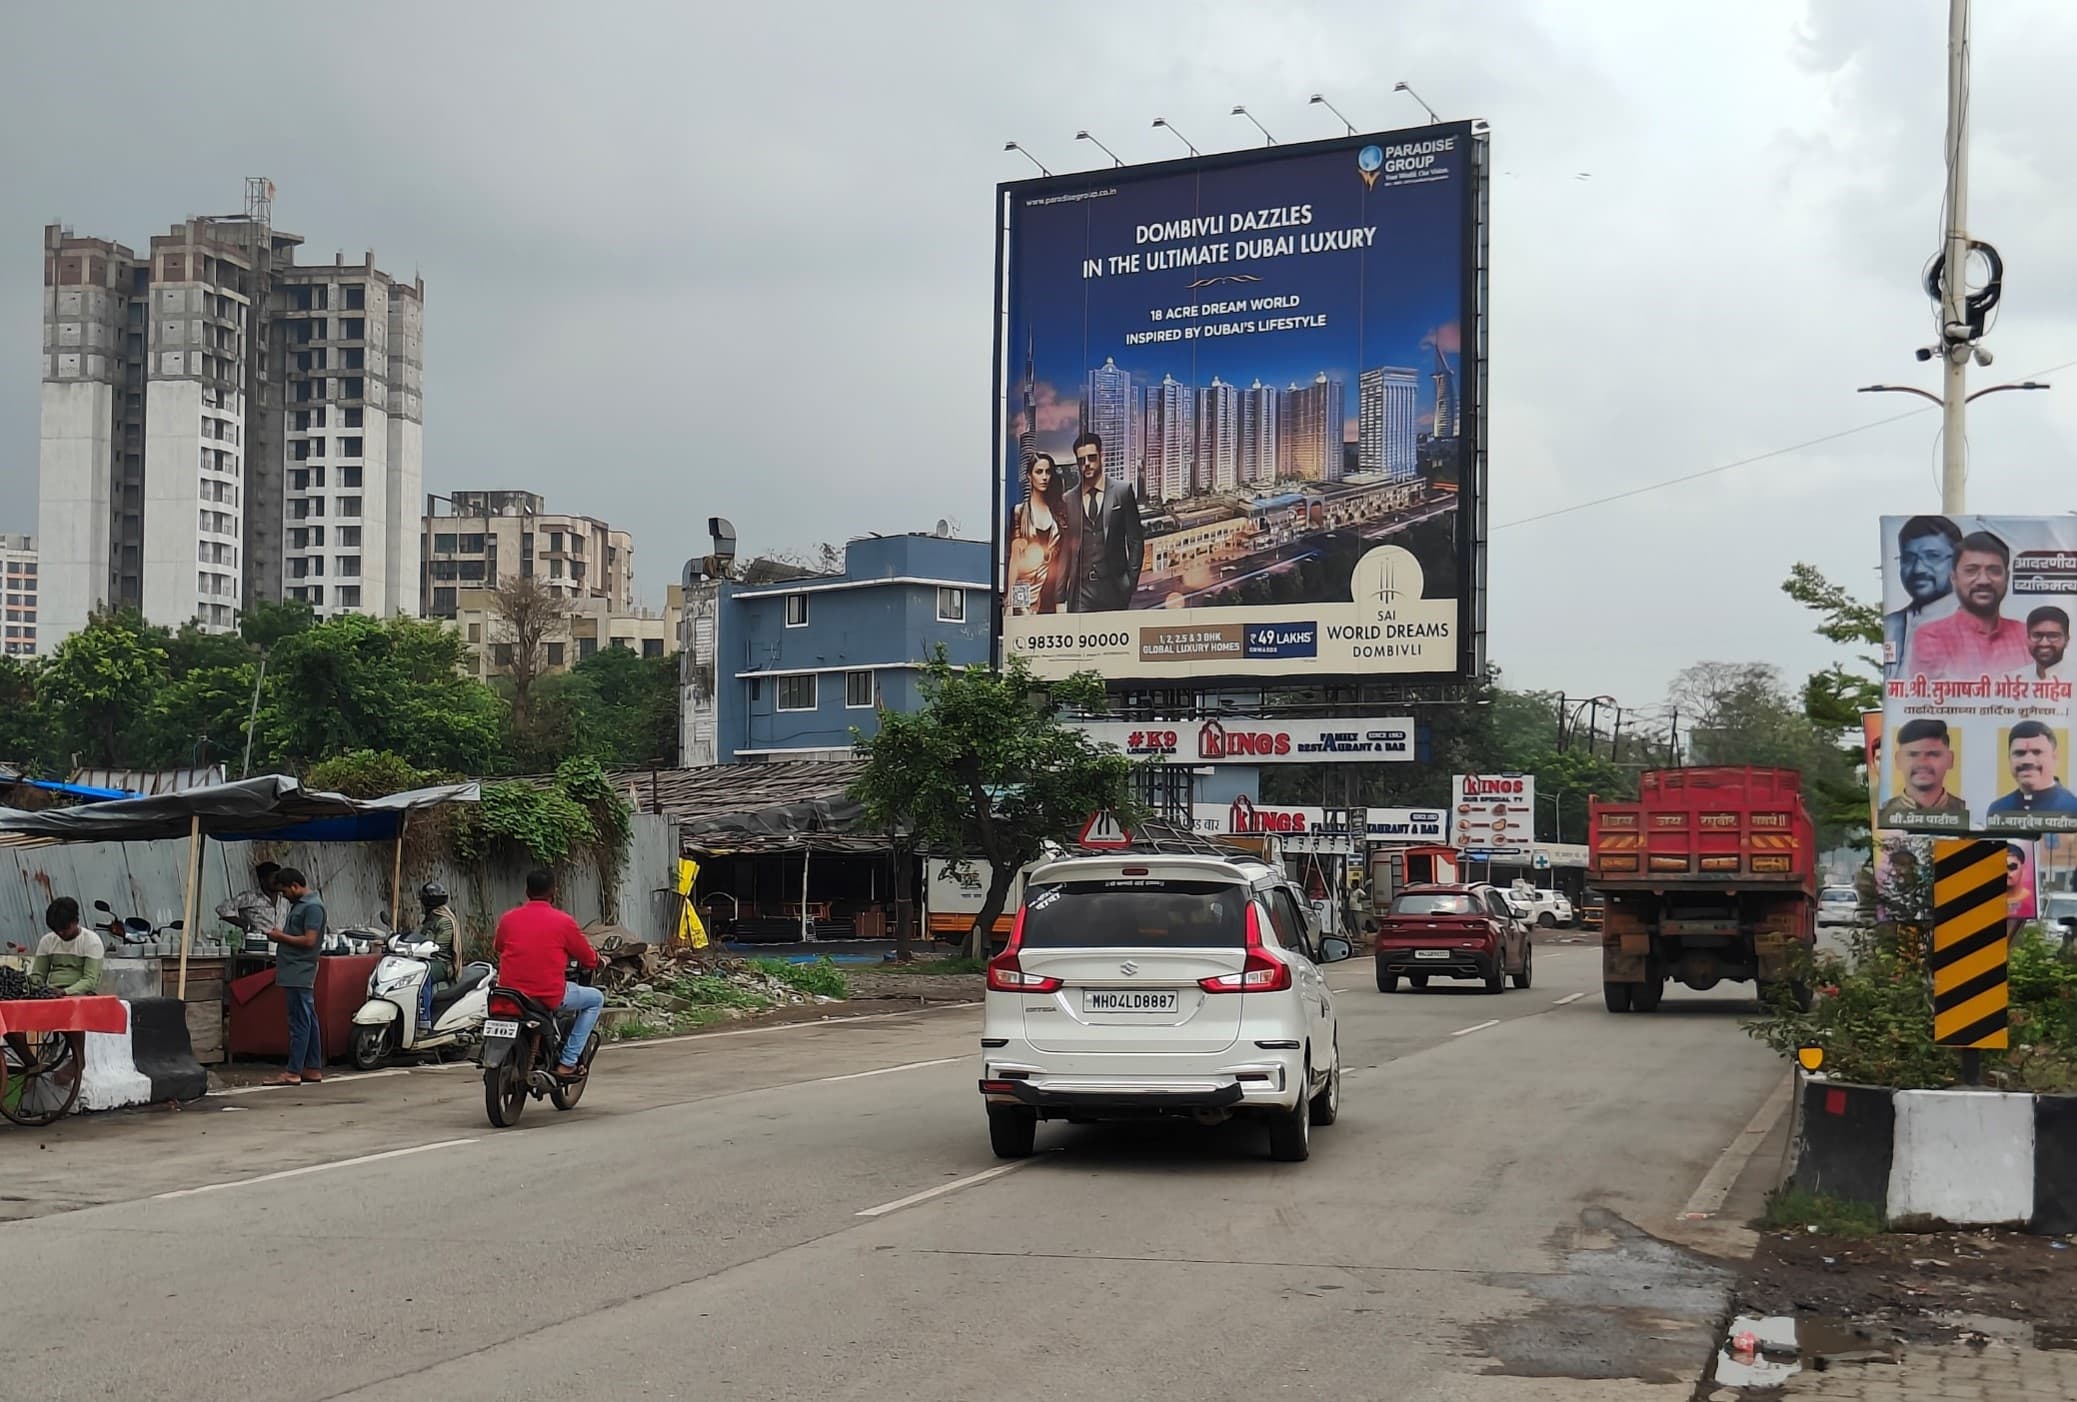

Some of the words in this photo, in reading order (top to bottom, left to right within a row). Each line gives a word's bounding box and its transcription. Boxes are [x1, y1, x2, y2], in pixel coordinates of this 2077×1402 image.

[1385, 138, 1454, 159] PARADISE
[1384, 155, 1435, 173] GROUP
[1136, 215, 1224, 245] DOMBIVLI
[1230, 204, 1313, 233] DAZZLES
[1082, 258, 1103, 279] IN
[1108, 254, 1140, 275] THE
[1146, 242, 1229, 272] ULTIMATE
[1235, 236, 1294, 261] DUBAI
[1300, 226, 1377, 254] LUXURY
[1150, 309, 1163, 321] 18
[1166, 305, 1199, 320] ACRE
[1201, 300, 1247, 316] DREAM
[1250, 295, 1300, 311] WORLD
[1126, 329, 1182, 346] INSPIRED
[1184, 326, 1202, 340] BY
[1204, 321, 1255, 338] DUBAI'S
[1257, 314, 1327, 333] LIFESTYLE
[1377, 610, 1396, 622] SAI
[1196, 633, 1202, 642] 3
[1203, 632, 1222, 642] BHK
[1326, 625, 1381, 640] WORLD
[1386, 623, 1449, 638] DREAMS
[1027, 634, 1074, 650] 98330
[1078, 632, 1130, 648] 90000
[1142, 644, 1175, 655] GLOBAL
[1175, 643, 1210, 653] LUXURY
[1210, 642, 1241, 652] HOMES
[1352, 644, 1422, 658] DOMBIVLI
[1995, 674, 2029, 701] भोईर
[2032, 675, 2073, 702] साहेब
[1384, 742, 1406, 752] BAR
[1926, 812, 1960, 825] पाटील
[1092, 993, 1175, 1009] MH04LD8887
